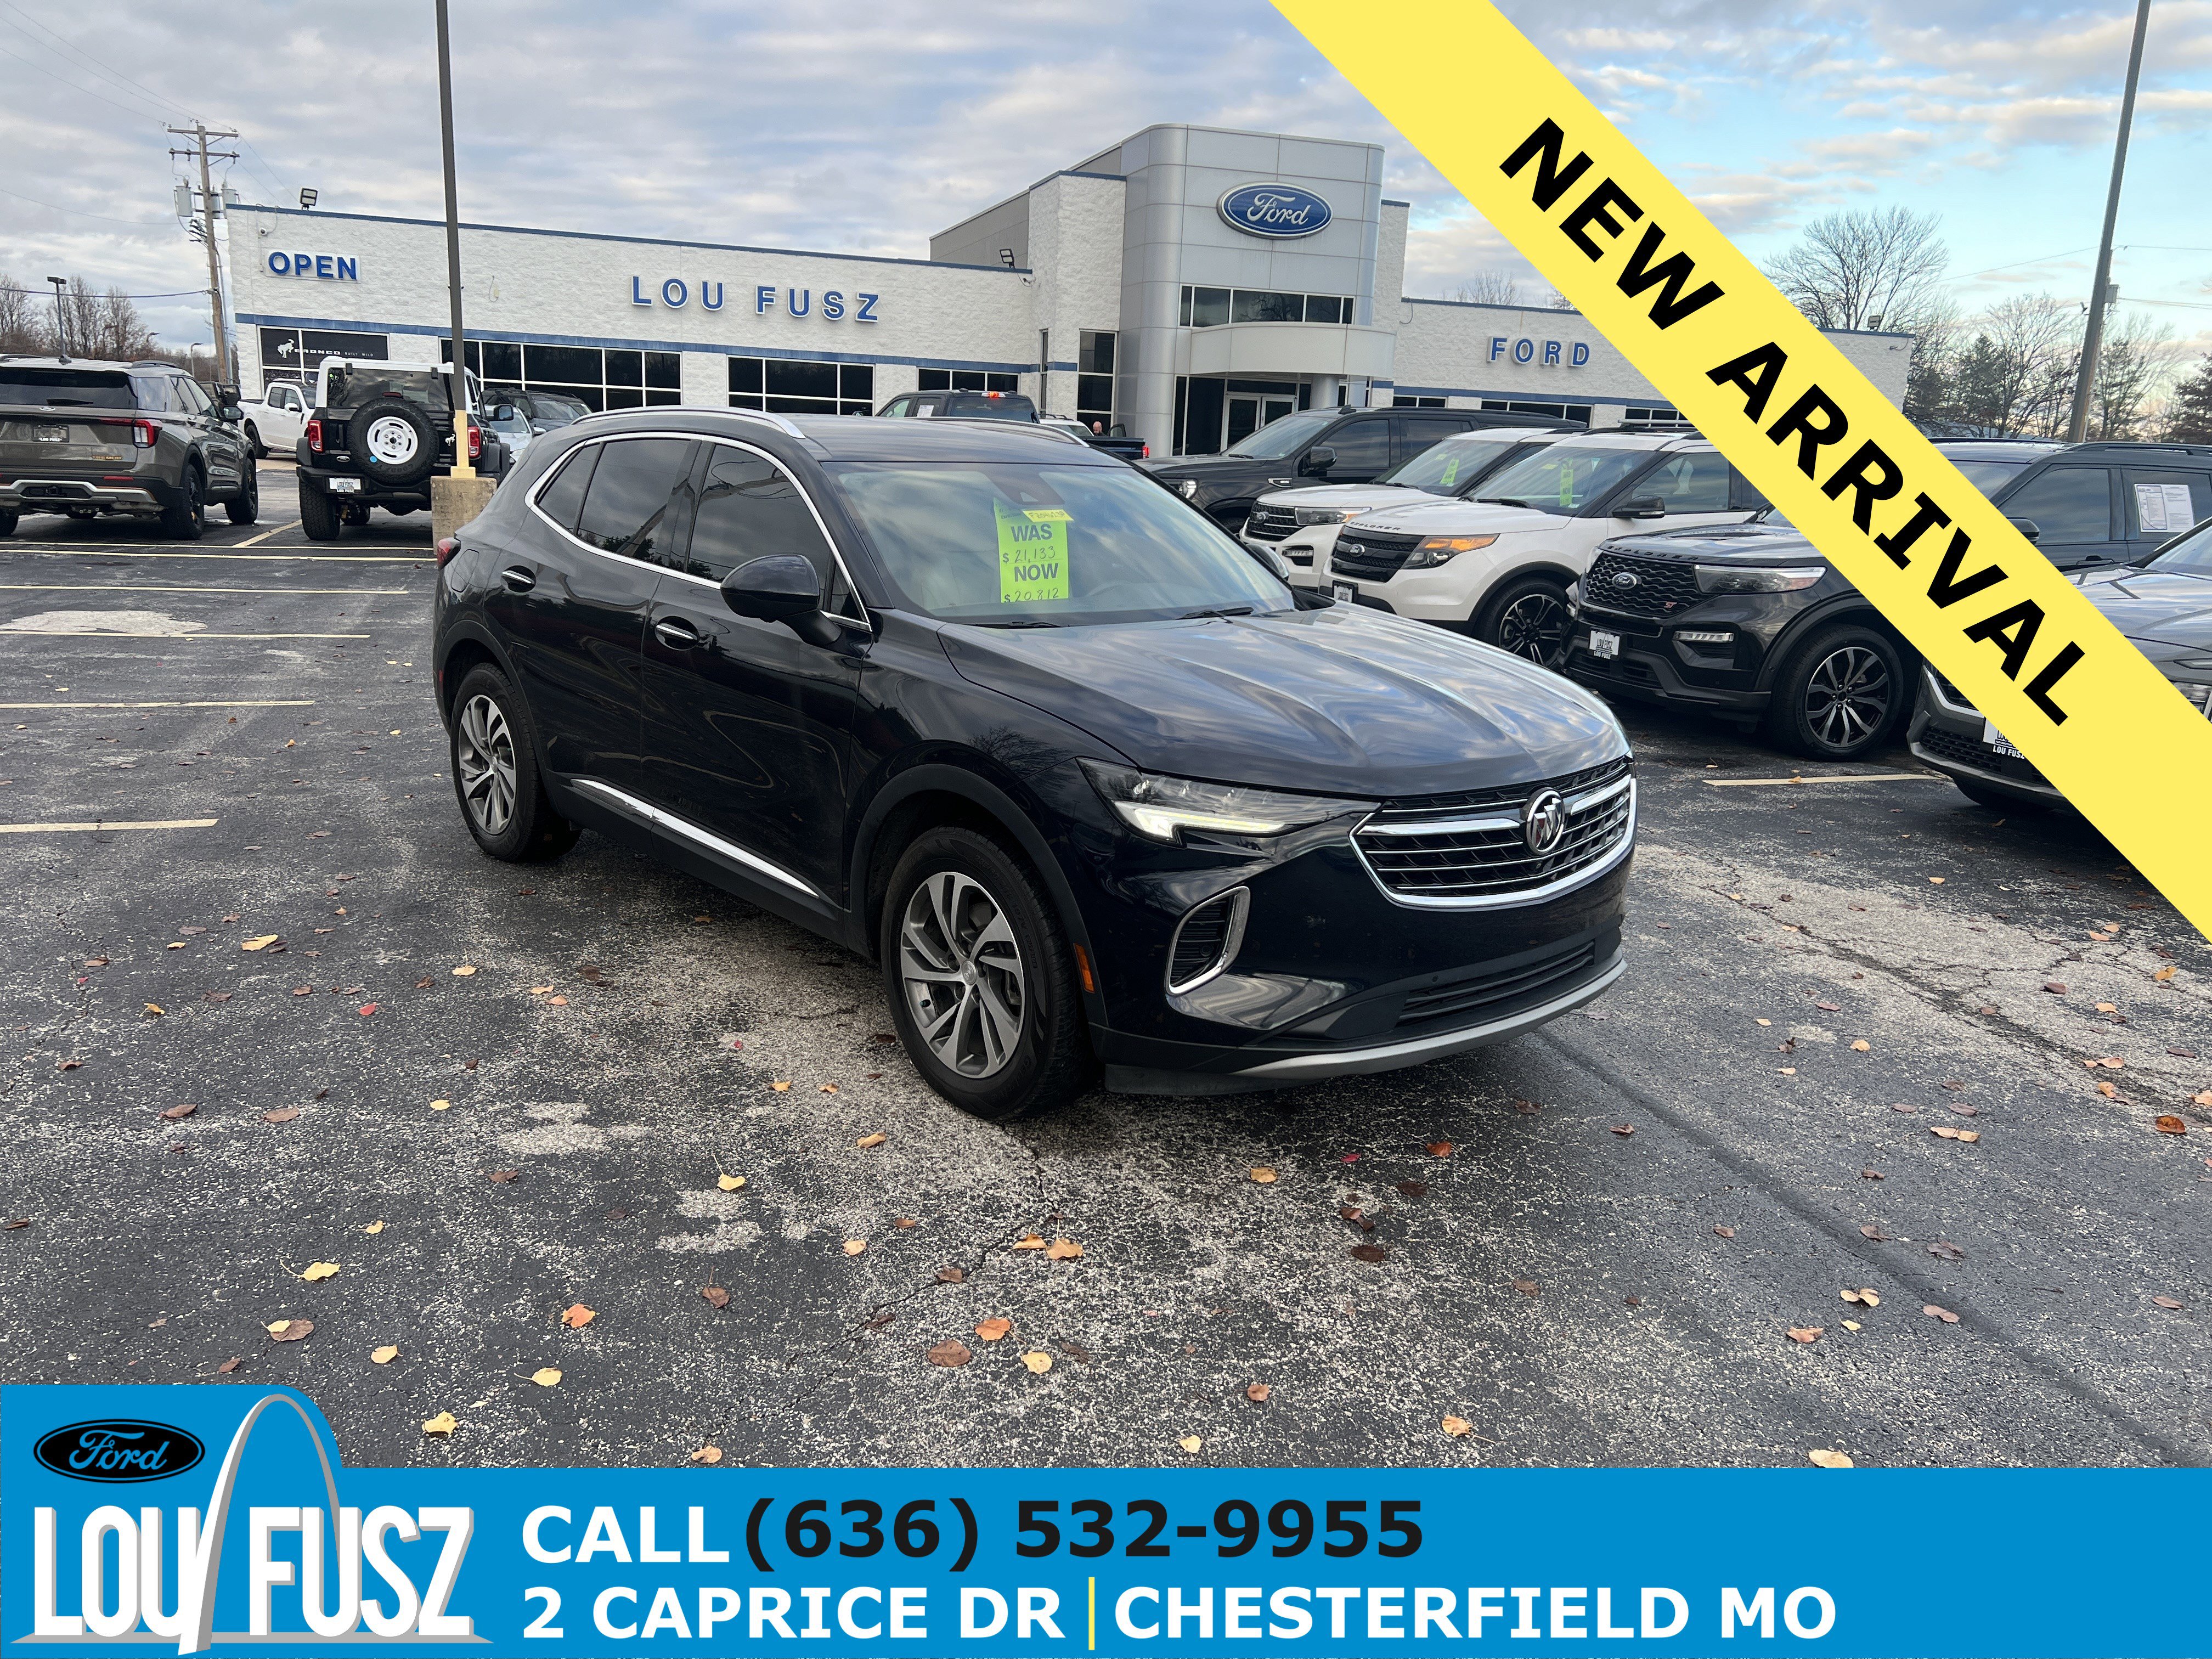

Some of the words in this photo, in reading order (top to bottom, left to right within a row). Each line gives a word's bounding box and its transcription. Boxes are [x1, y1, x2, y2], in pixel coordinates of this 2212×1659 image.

[1246, 193, 1311, 225] Ford
[268, 251, 357, 280] OPEN
[631, 275, 725, 311] LOU
[756, 285, 879, 323] FUSZ
[1487, 336, 1590, 367] FORD
[1011, 523, 1052, 542] WAS
[1350, 521, 1401, 531] EXPLORER
[1607, 545, 1699, 561] EXPLORER
[1014, 563, 1059, 582] NOW
[1993, 745, 2006, 754] LOU
